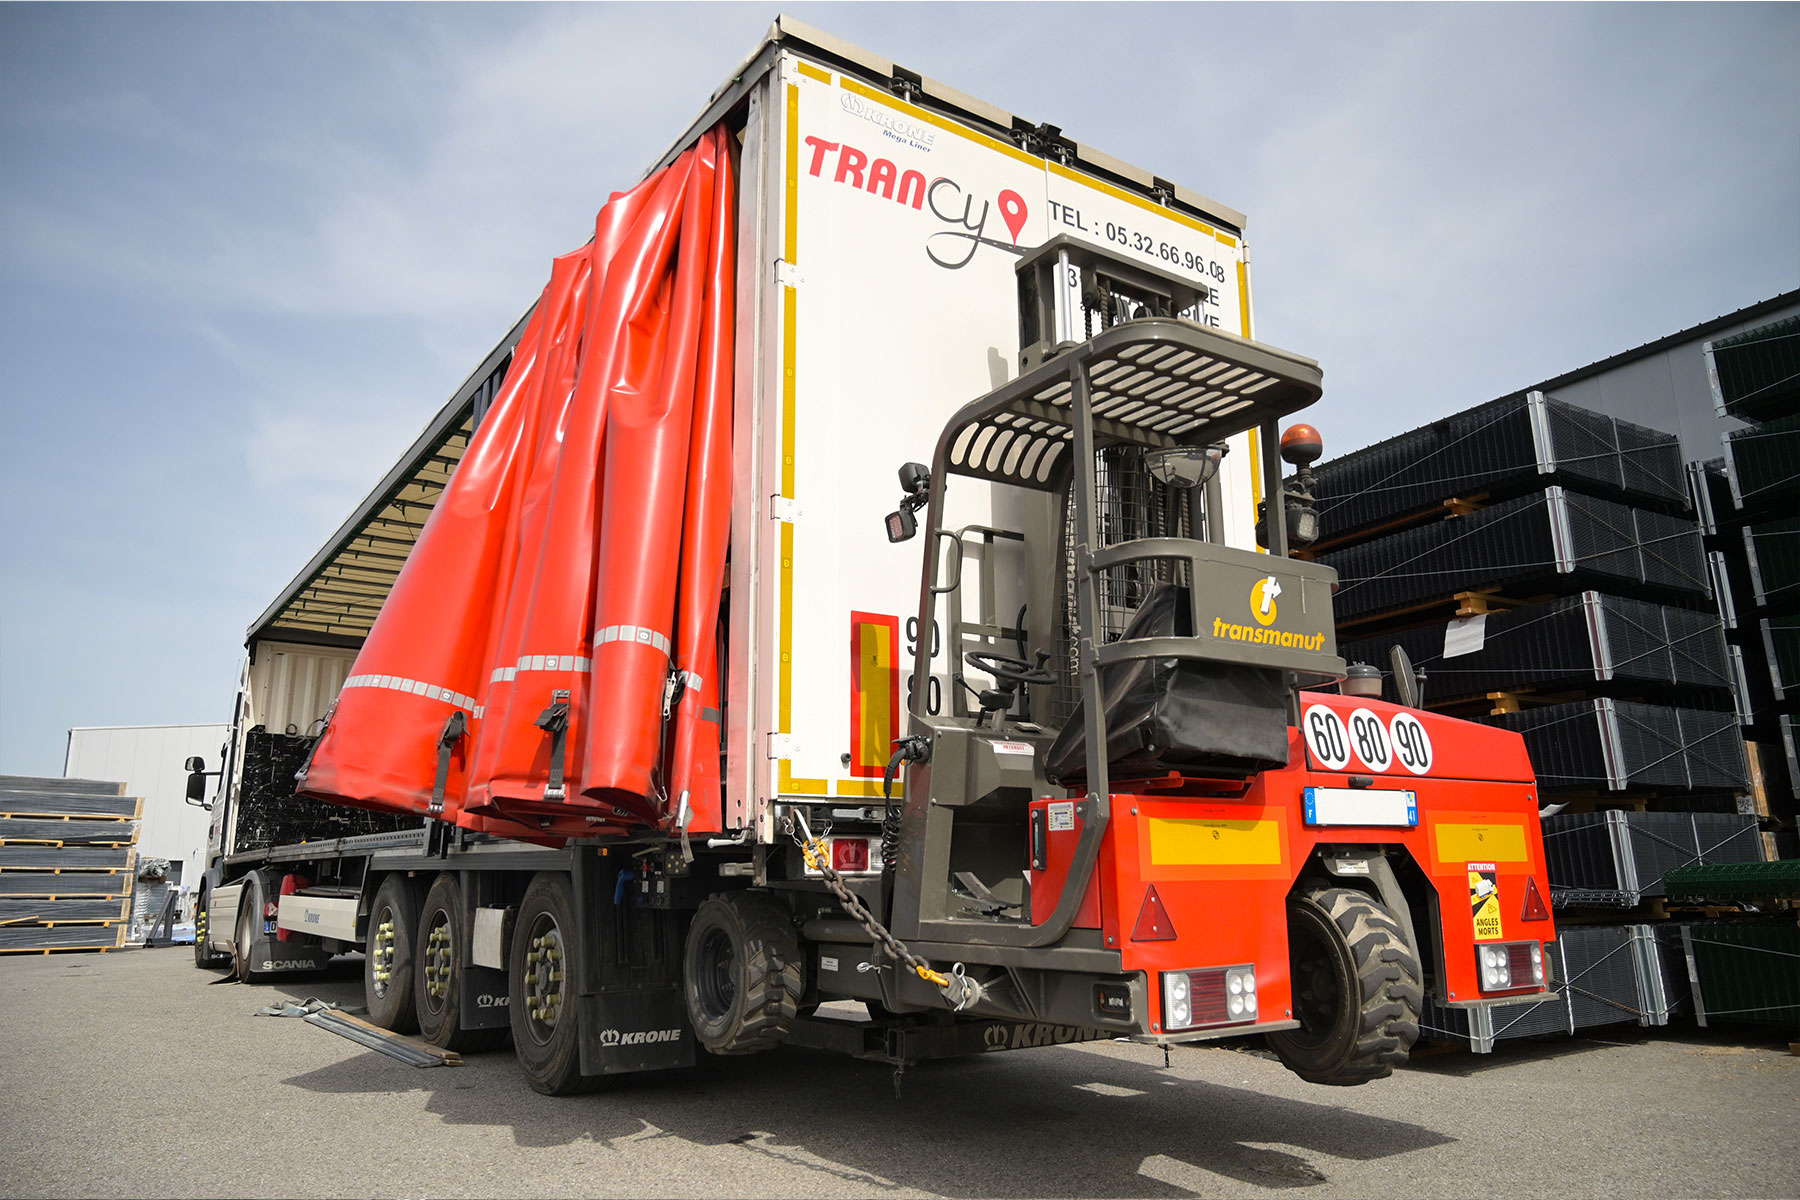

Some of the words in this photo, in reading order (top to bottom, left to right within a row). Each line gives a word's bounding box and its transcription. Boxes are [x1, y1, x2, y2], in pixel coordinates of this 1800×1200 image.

[864, 107, 935, 145] KRONE
[883, 129, 907, 143] Mega
[909, 140, 932, 153] Liner
[1049, 200, 1088, 232] TEL
[1106, 222, 1225, 283] 05.32.66.96.08
[1213, 617, 1325, 651] transmanut
[1310, 712, 1345, 762] 60
[1353, 715, 1387, 764] 80
[1395, 720, 1428, 768] 90
[1408, 810, 1416, 821] 41
[1467, 863, 1496, 871] ATTENTION
[1476, 918, 1499, 927] ANGLES
[1477, 927, 1499, 936] MORTS
[262, 960, 316, 970] SCANIA
[621, 1029, 681, 1046] KRONE
